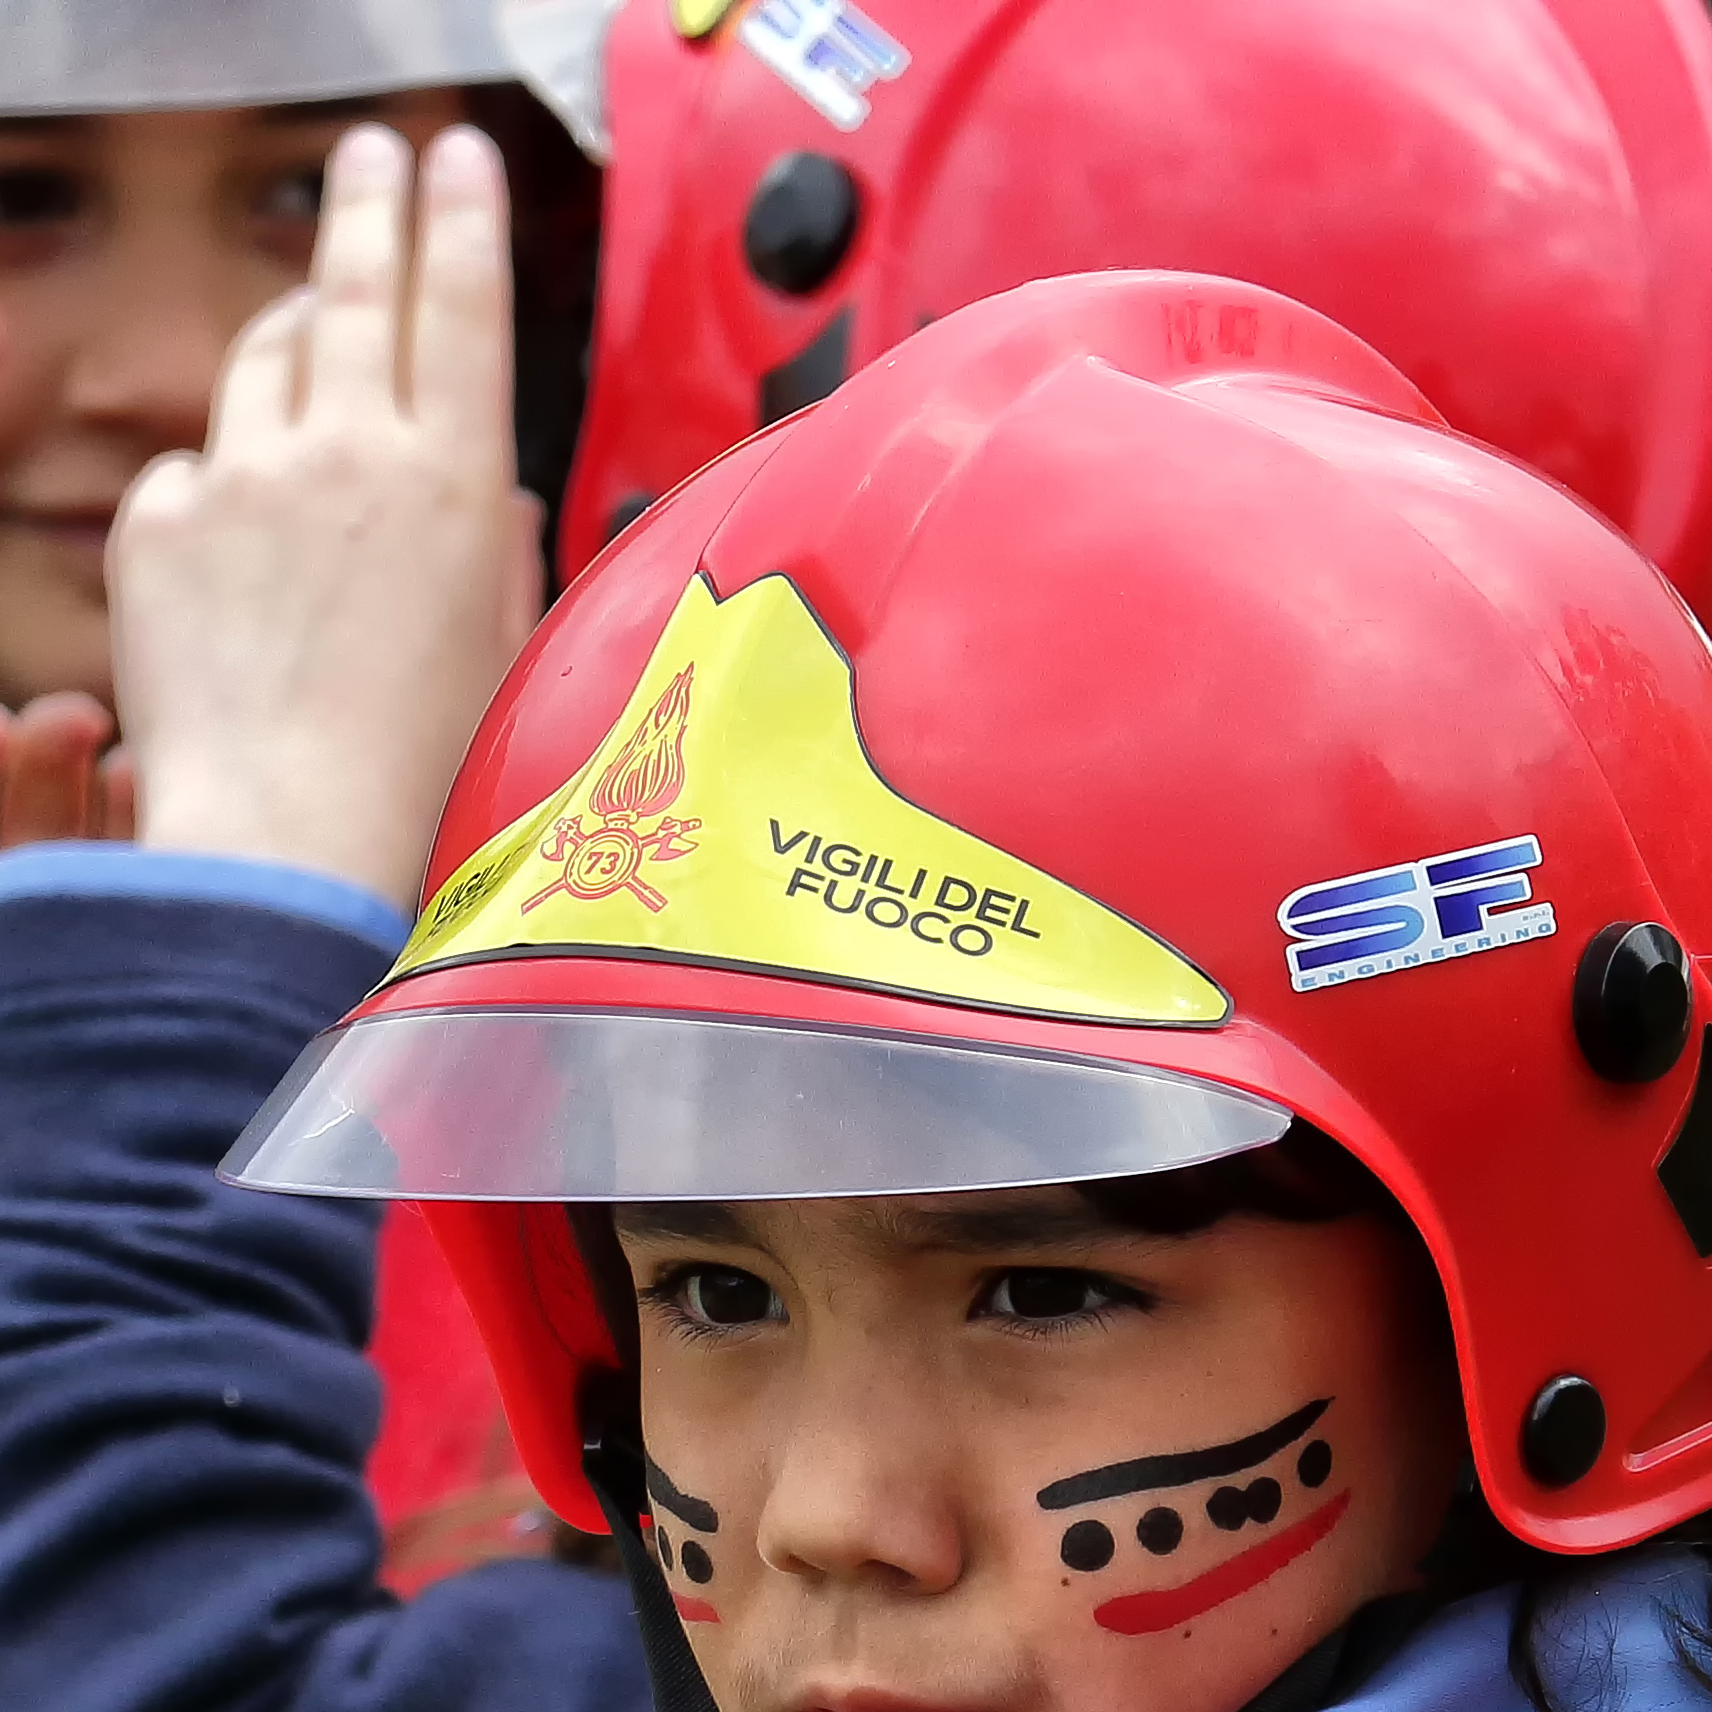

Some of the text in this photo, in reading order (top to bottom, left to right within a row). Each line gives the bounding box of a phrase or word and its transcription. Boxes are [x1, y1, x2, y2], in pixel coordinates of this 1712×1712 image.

[583, 851, 620, 875] 73
[769, 817, 1041, 939] VIGILI DEL
[1287, 841, 1538, 972] SF
[785, 867, 994, 957] FUOCO
[1300, 922, 1553, 989] ENGINEERING
